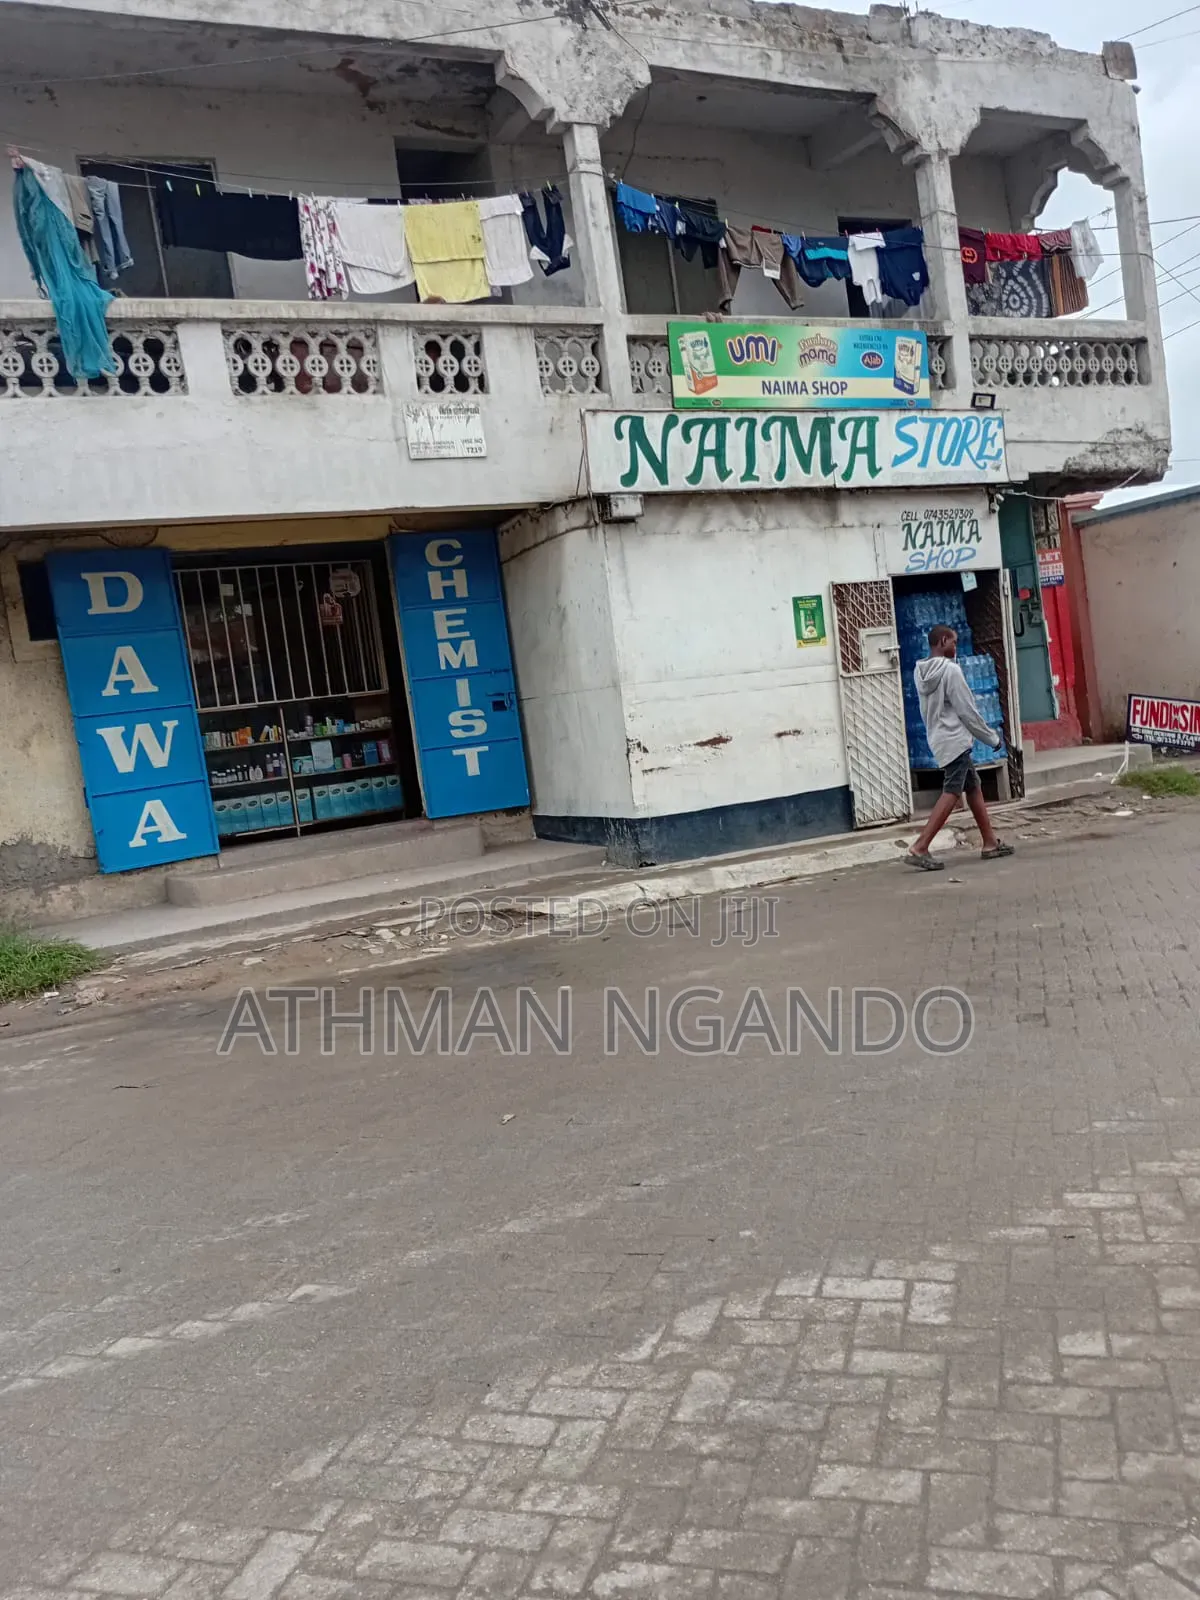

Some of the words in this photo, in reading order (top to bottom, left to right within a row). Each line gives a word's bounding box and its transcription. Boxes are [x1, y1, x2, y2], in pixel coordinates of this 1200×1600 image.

[799, 347, 837, 367] mama
[762, 379, 809, 396] NAIMA
[812, 380, 848, 396] SHOP
[614, 414, 883, 488] NAIMA
[891, 415, 1003, 470] STORE
[901, 510, 918, 521] CELL
[923, 508, 974, 520] 0743529309
[902, 518, 982, 551] NAIMA
[905, 546, 976, 573] SHOP
[1038, 552, 1060, 562] LET
[424, 538, 490, 777] CHEMIST
[80, 570, 188, 848] DAWA
[1132, 699, 1172, 729] FUNDI
